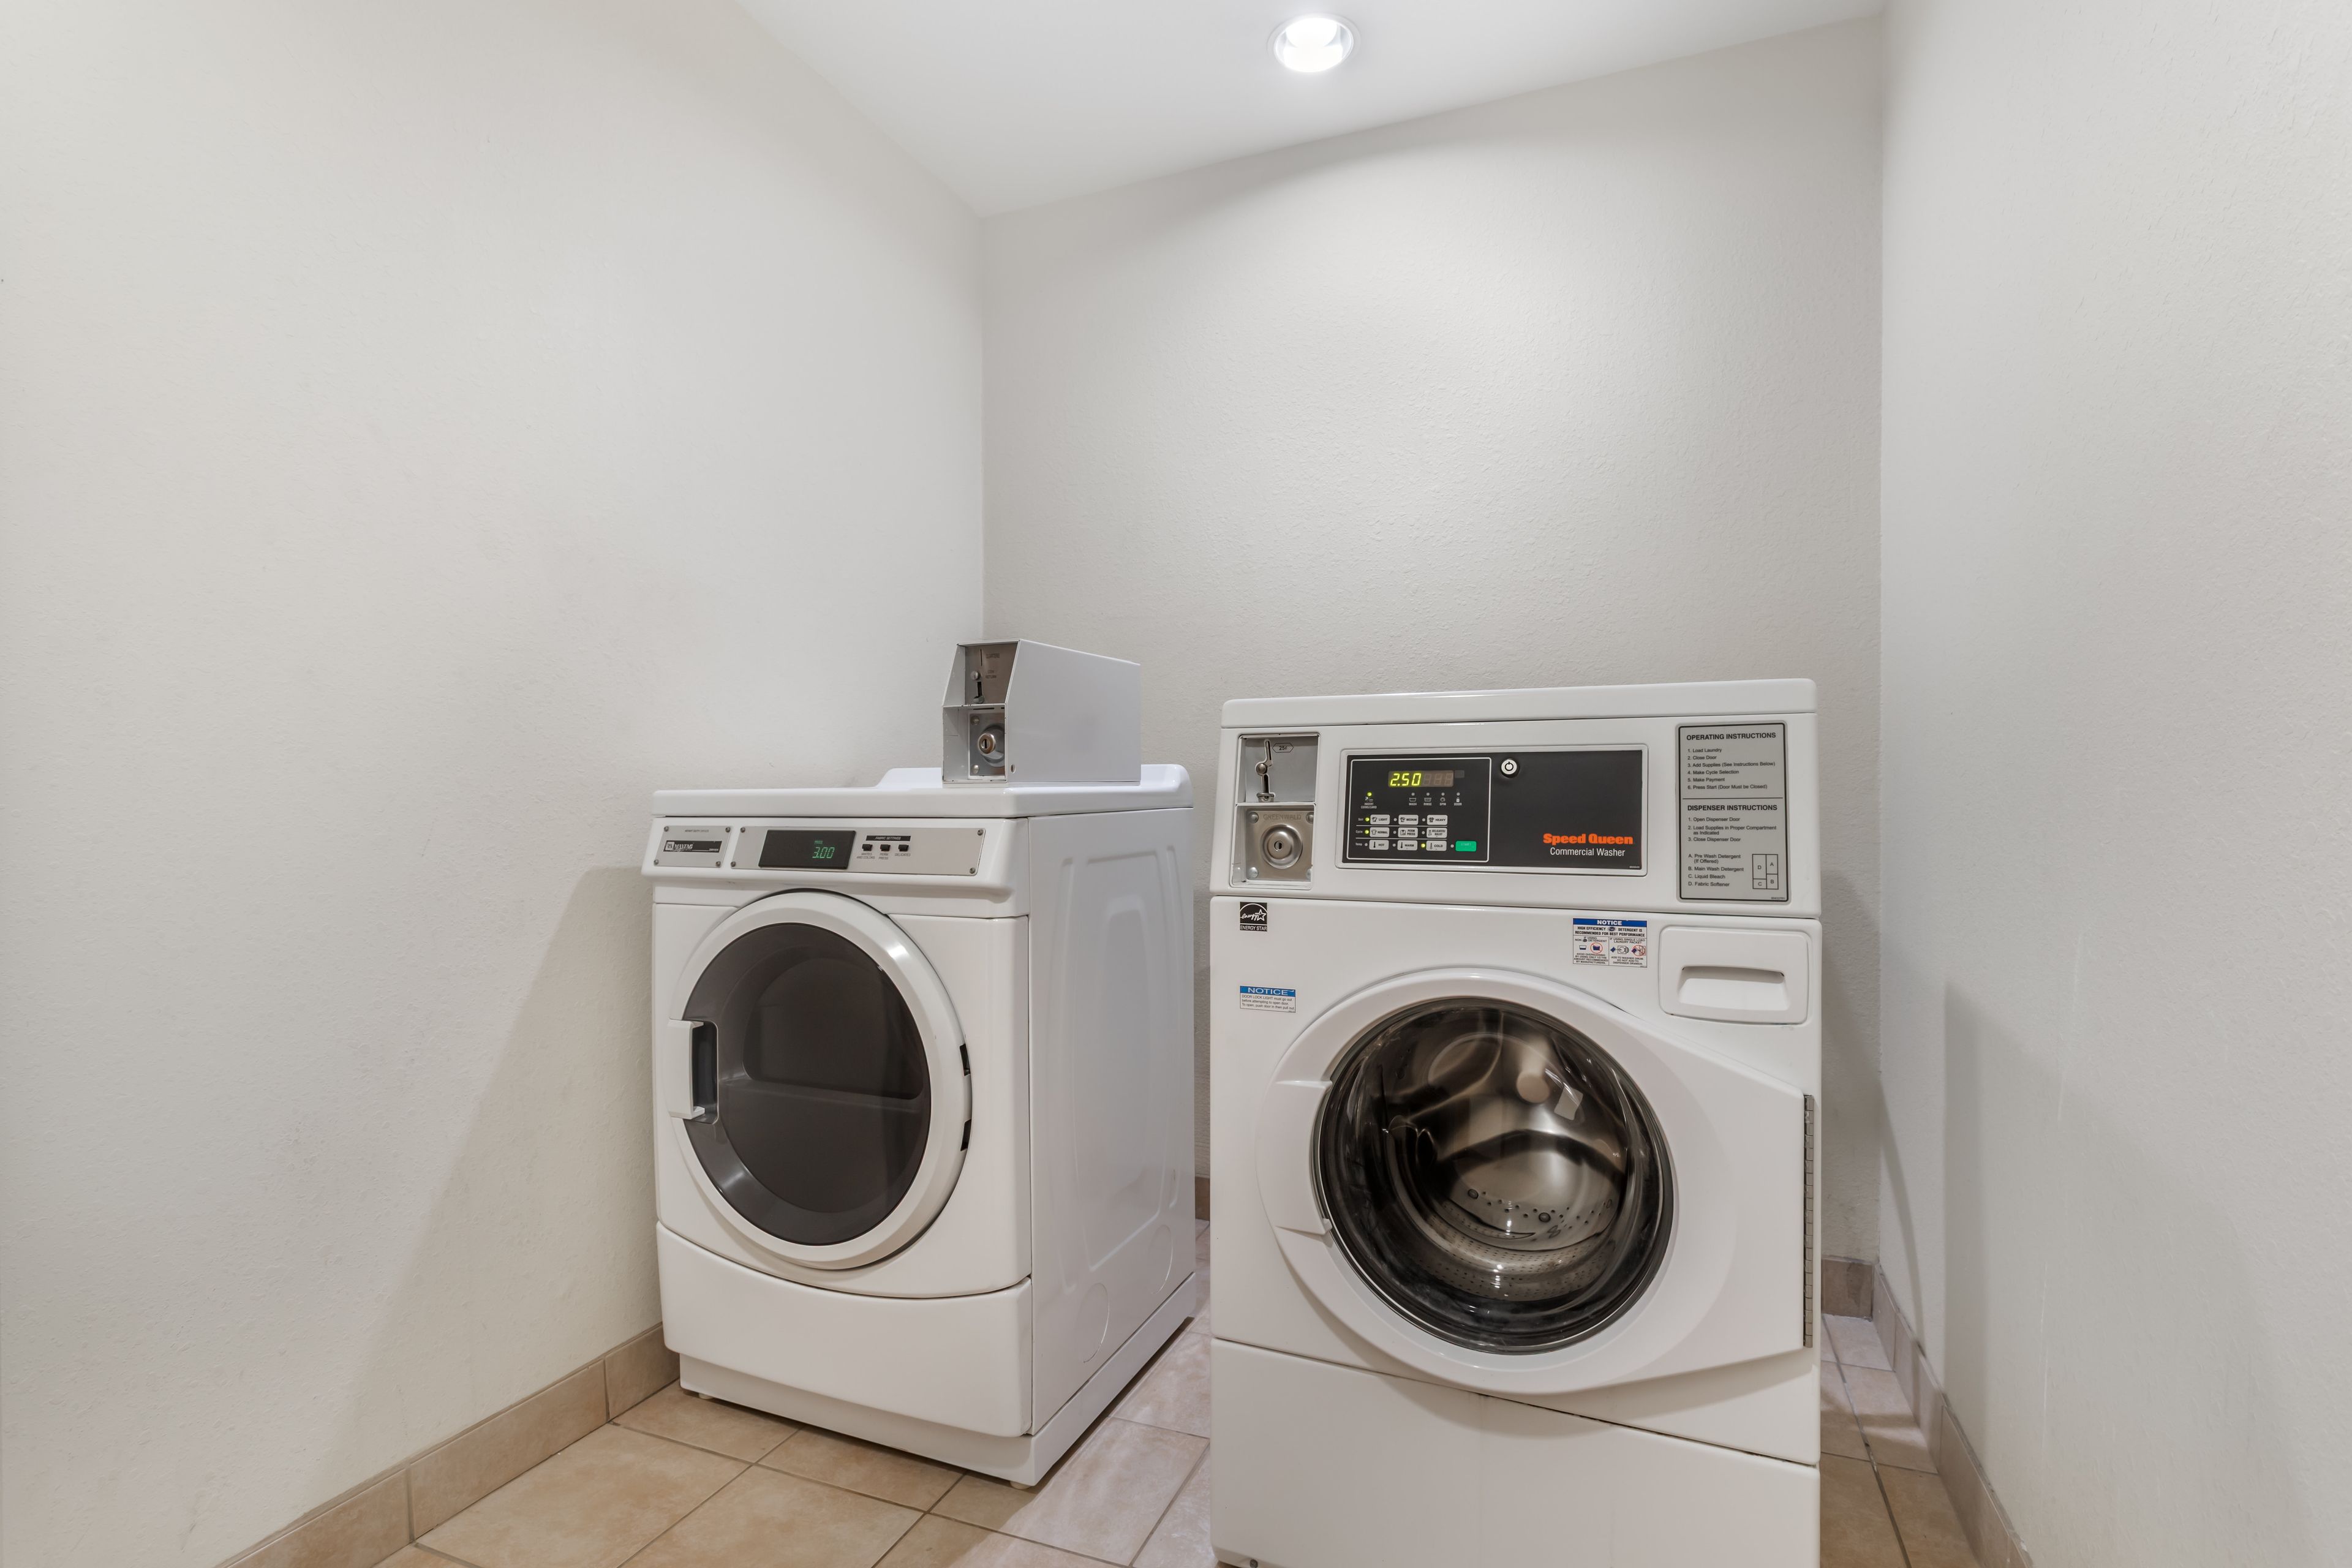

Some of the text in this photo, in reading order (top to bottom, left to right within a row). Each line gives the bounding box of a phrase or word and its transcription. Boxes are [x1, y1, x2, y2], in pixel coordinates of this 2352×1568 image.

[1390, 773, 1422, 786] 2.50
[1543, 833, 1634, 845] Speed Queen
[813, 847, 835, 858] 3.00
[1550, 847, 1594, 856] Commercial
